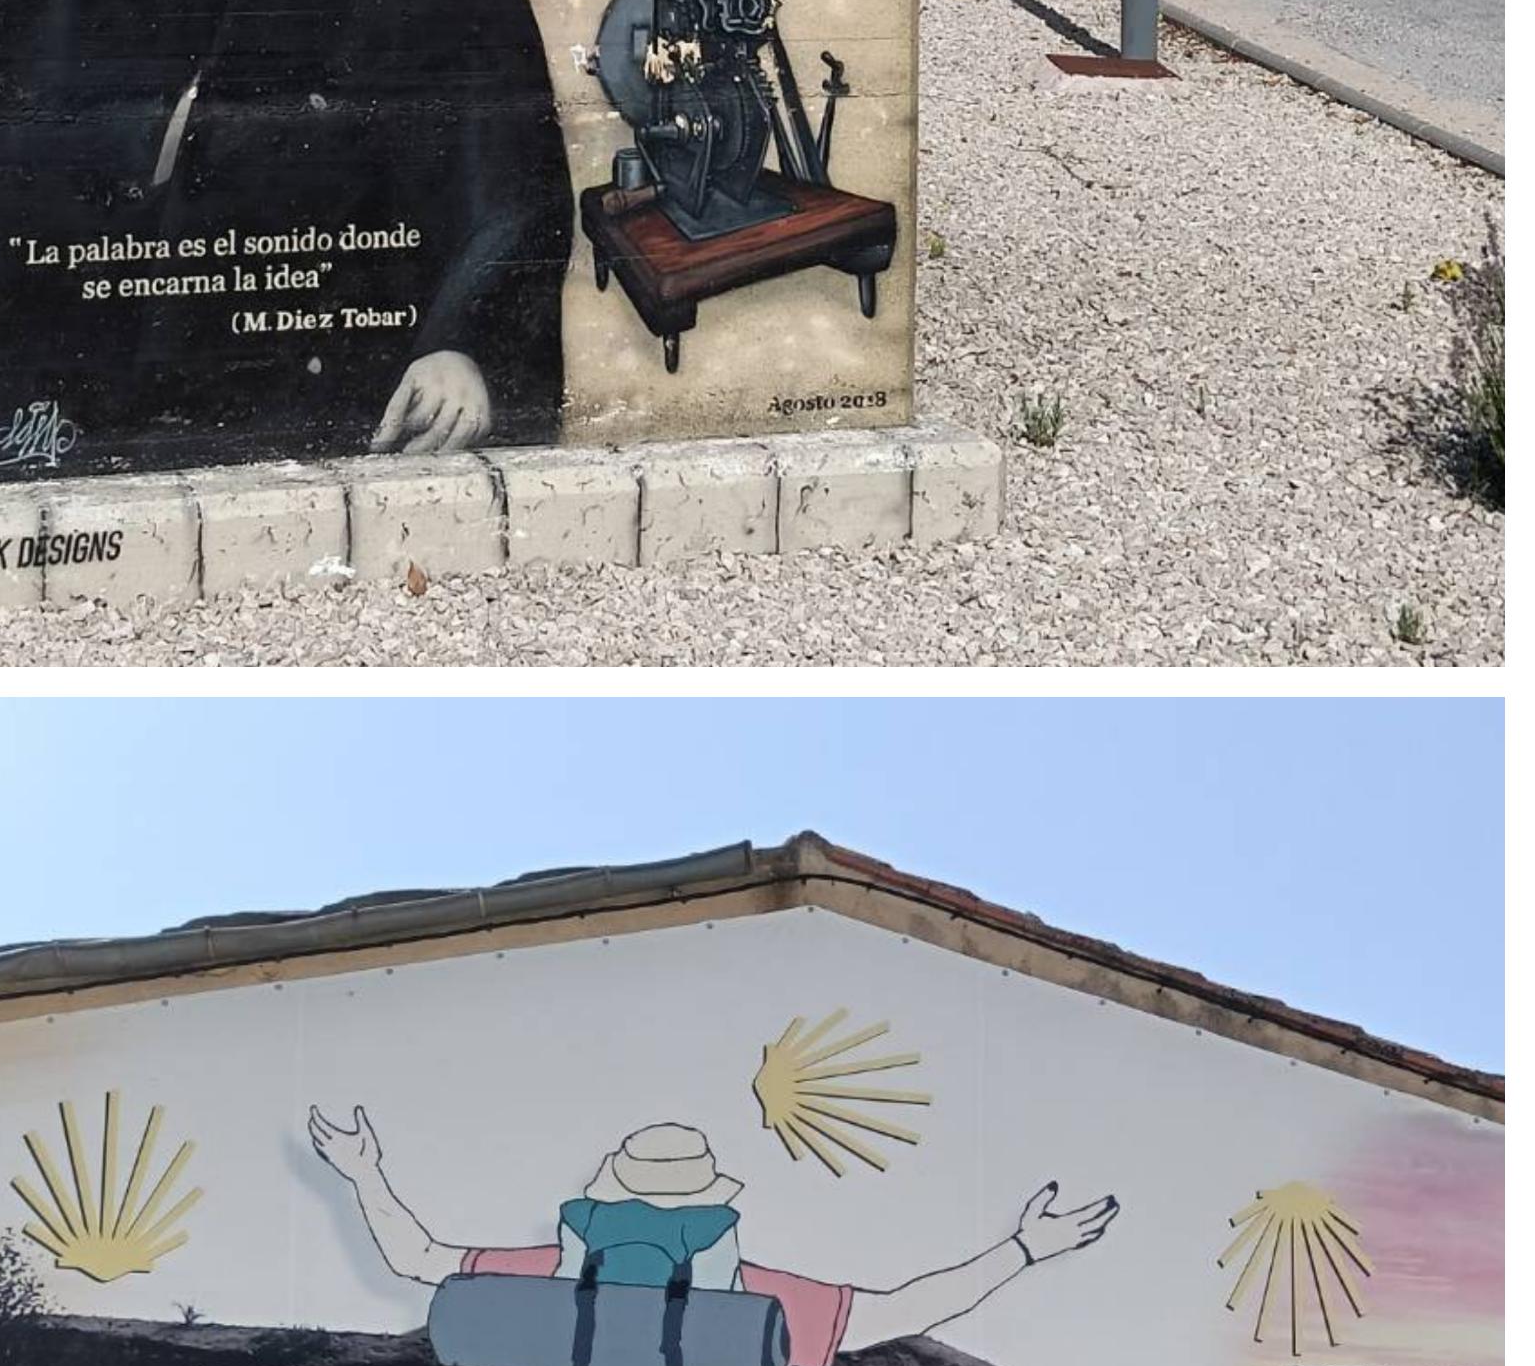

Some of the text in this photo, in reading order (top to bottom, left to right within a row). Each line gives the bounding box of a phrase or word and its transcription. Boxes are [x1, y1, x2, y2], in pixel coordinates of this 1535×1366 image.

[68, 234, 171, 269] palabra
[178, 236, 206, 257] es
[213, 229, 237, 255] el
[243, 226, 333, 255] sonido
[338, 223, 422, 251] donde
[82, 279, 111, 300] se
[119, 274, 227, 297] encarna
[233, 266, 258, 293] la
[277, 310, 333, 331] Diez
[341, 305, 417, 329] Tobar)
[767, 395, 835, 416] Agosto
[17, 530, 124, 568] DESIGNS
